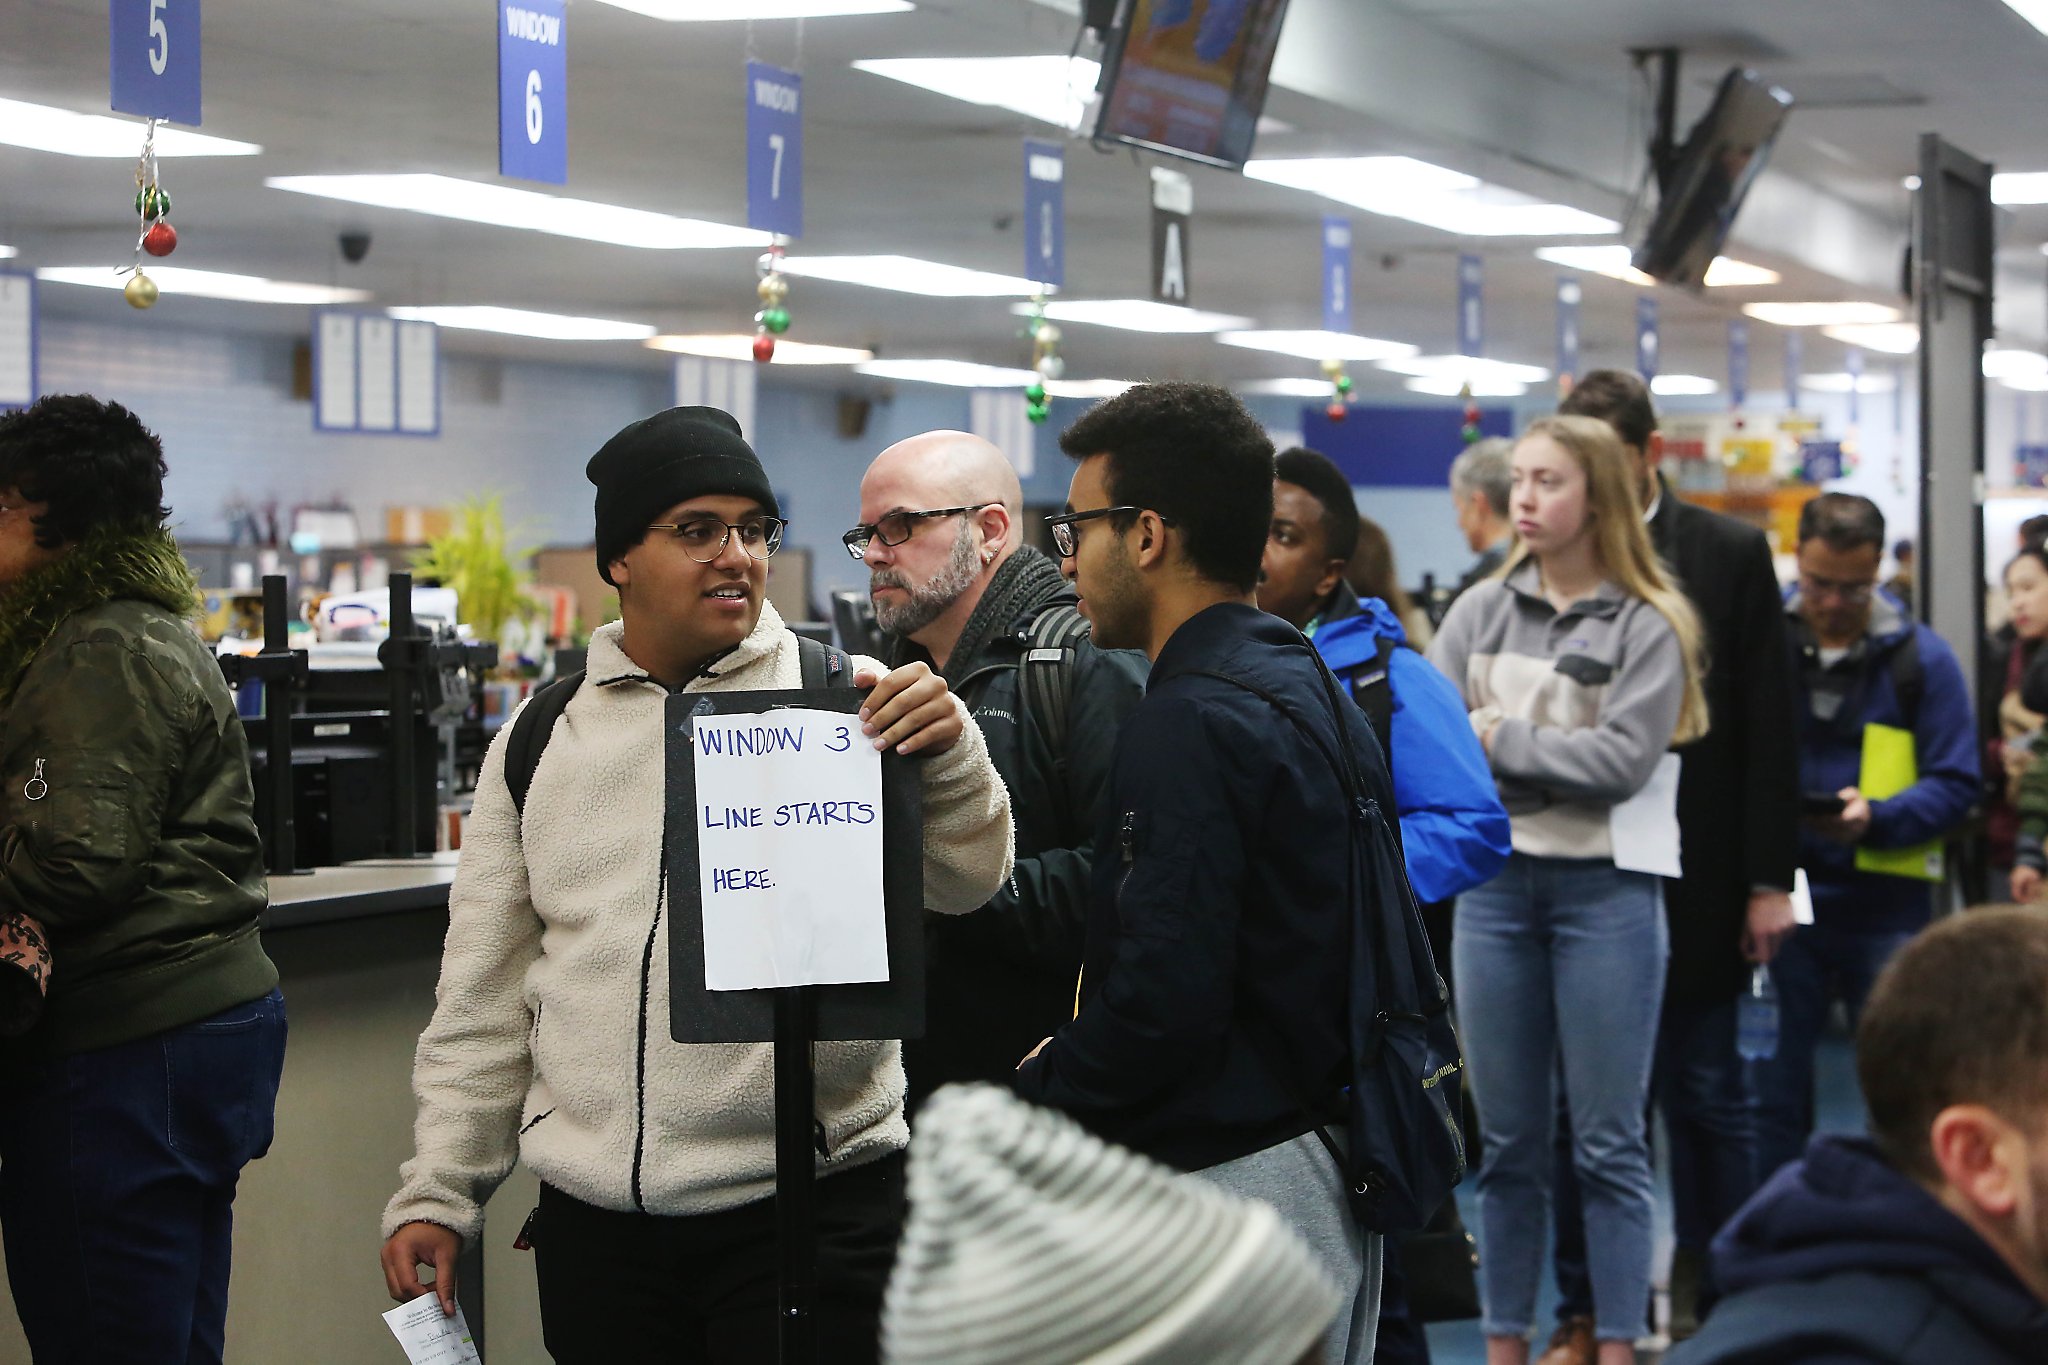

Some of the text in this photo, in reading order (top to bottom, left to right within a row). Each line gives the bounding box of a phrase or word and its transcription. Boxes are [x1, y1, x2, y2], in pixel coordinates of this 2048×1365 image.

[149, 0, 168, 75] 5
[506, 6, 561, 46] WINDOW
[526, 69, 543, 144] 6
[754, 78, 799, 114] WINDOW
[769, 133, 785, 200] 7
[1161, 222, 1186, 301] A
[699, 726, 851, 757] WINDOW 3
[705, 801, 876, 830] LINE STARTS
[713, 867, 776, 893] HERE.
